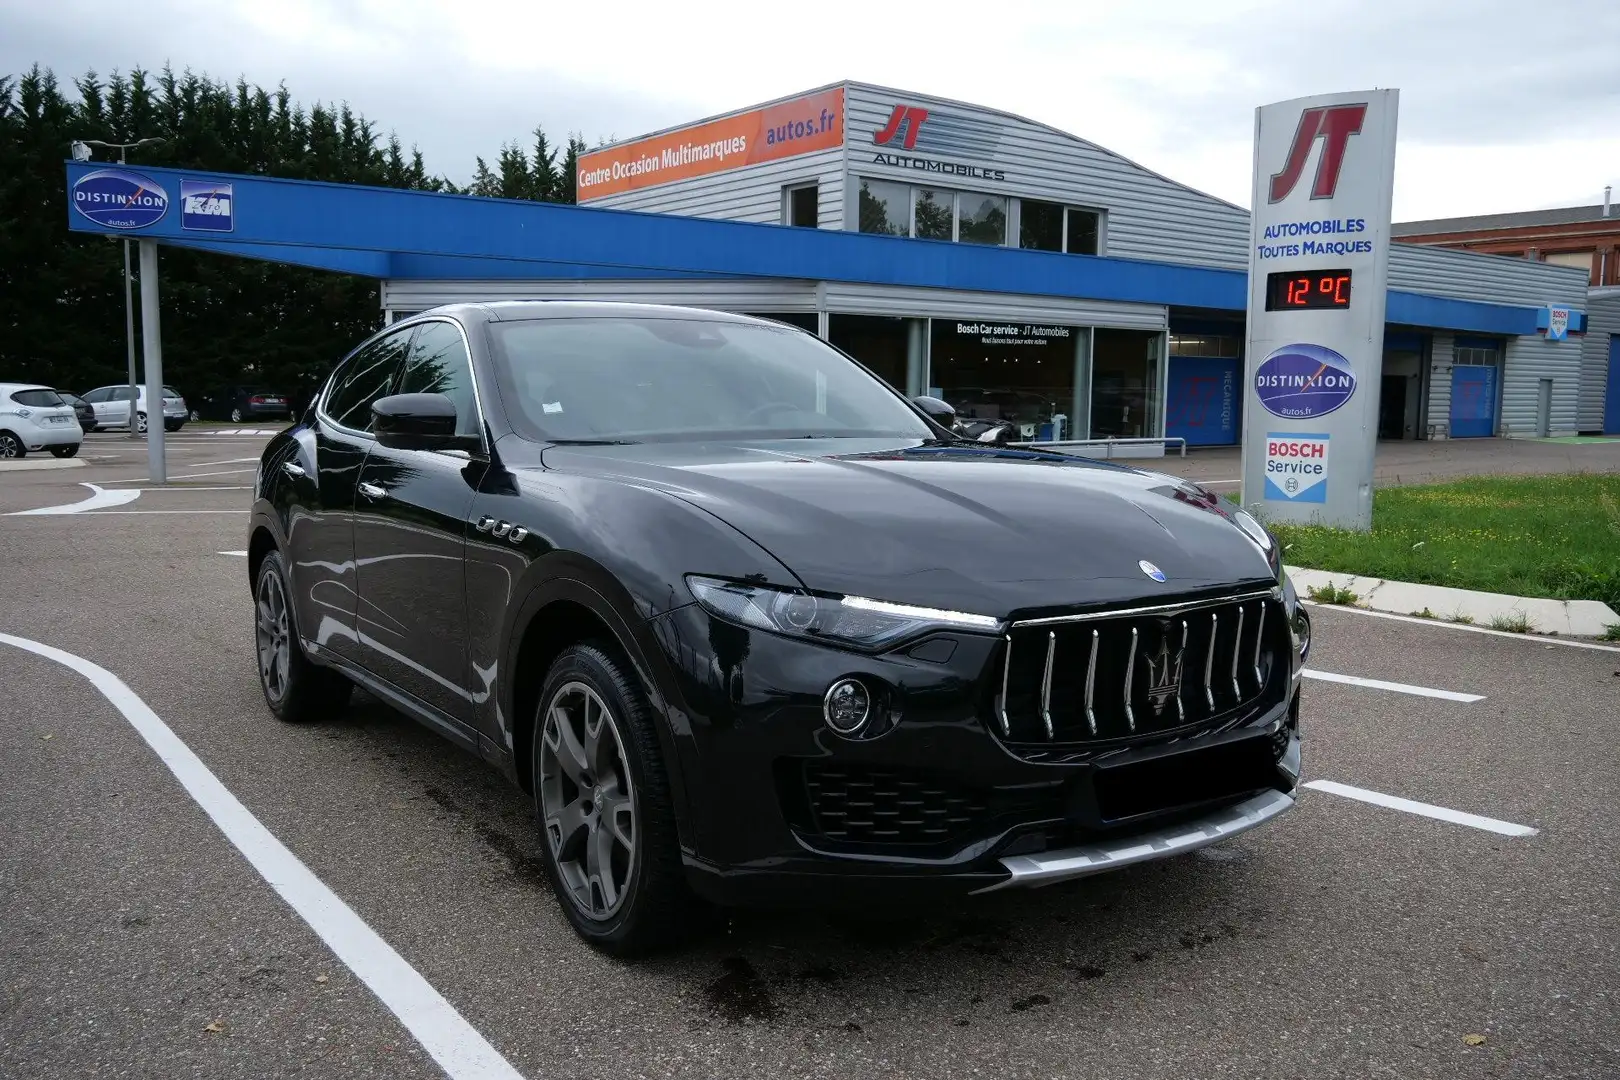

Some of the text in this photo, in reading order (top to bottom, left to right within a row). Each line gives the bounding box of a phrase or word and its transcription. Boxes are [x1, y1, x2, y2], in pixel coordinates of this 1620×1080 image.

[767, 108, 835, 146] autos.fr
[872, 103, 929, 151] JT
[579, 135, 746, 188] Centre Occasion Multimarques
[1268, 102, 1368, 205] JT
[873, 153, 1005, 181] AUTOMOBILES
[76, 191, 163, 207] DISTINXION
[107, 218, 136, 227] autos.fr
[1264, 218, 1365, 239] AUTOMOBILES
[1258, 240, 1372, 260] TOUTES MARQUES
[1286, 279, 1310, 305] 12
[1552, 310, 1567, 319] BOSCH
[957, 323, 979, 334] Bosch
[980, 323, 993, 334] Car
[993, 324, 1019, 335] service
[1022, 325, 1031, 336] JT
[1031, 326, 1070, 338] Automobiles
[1257, 374, 1350, 388] DISTINXION
[1281, 406, 1313, 416] autos.fr
[1268, 442, 1324, 458] BOSCH
[1267, 459, 1323, 475] Service
